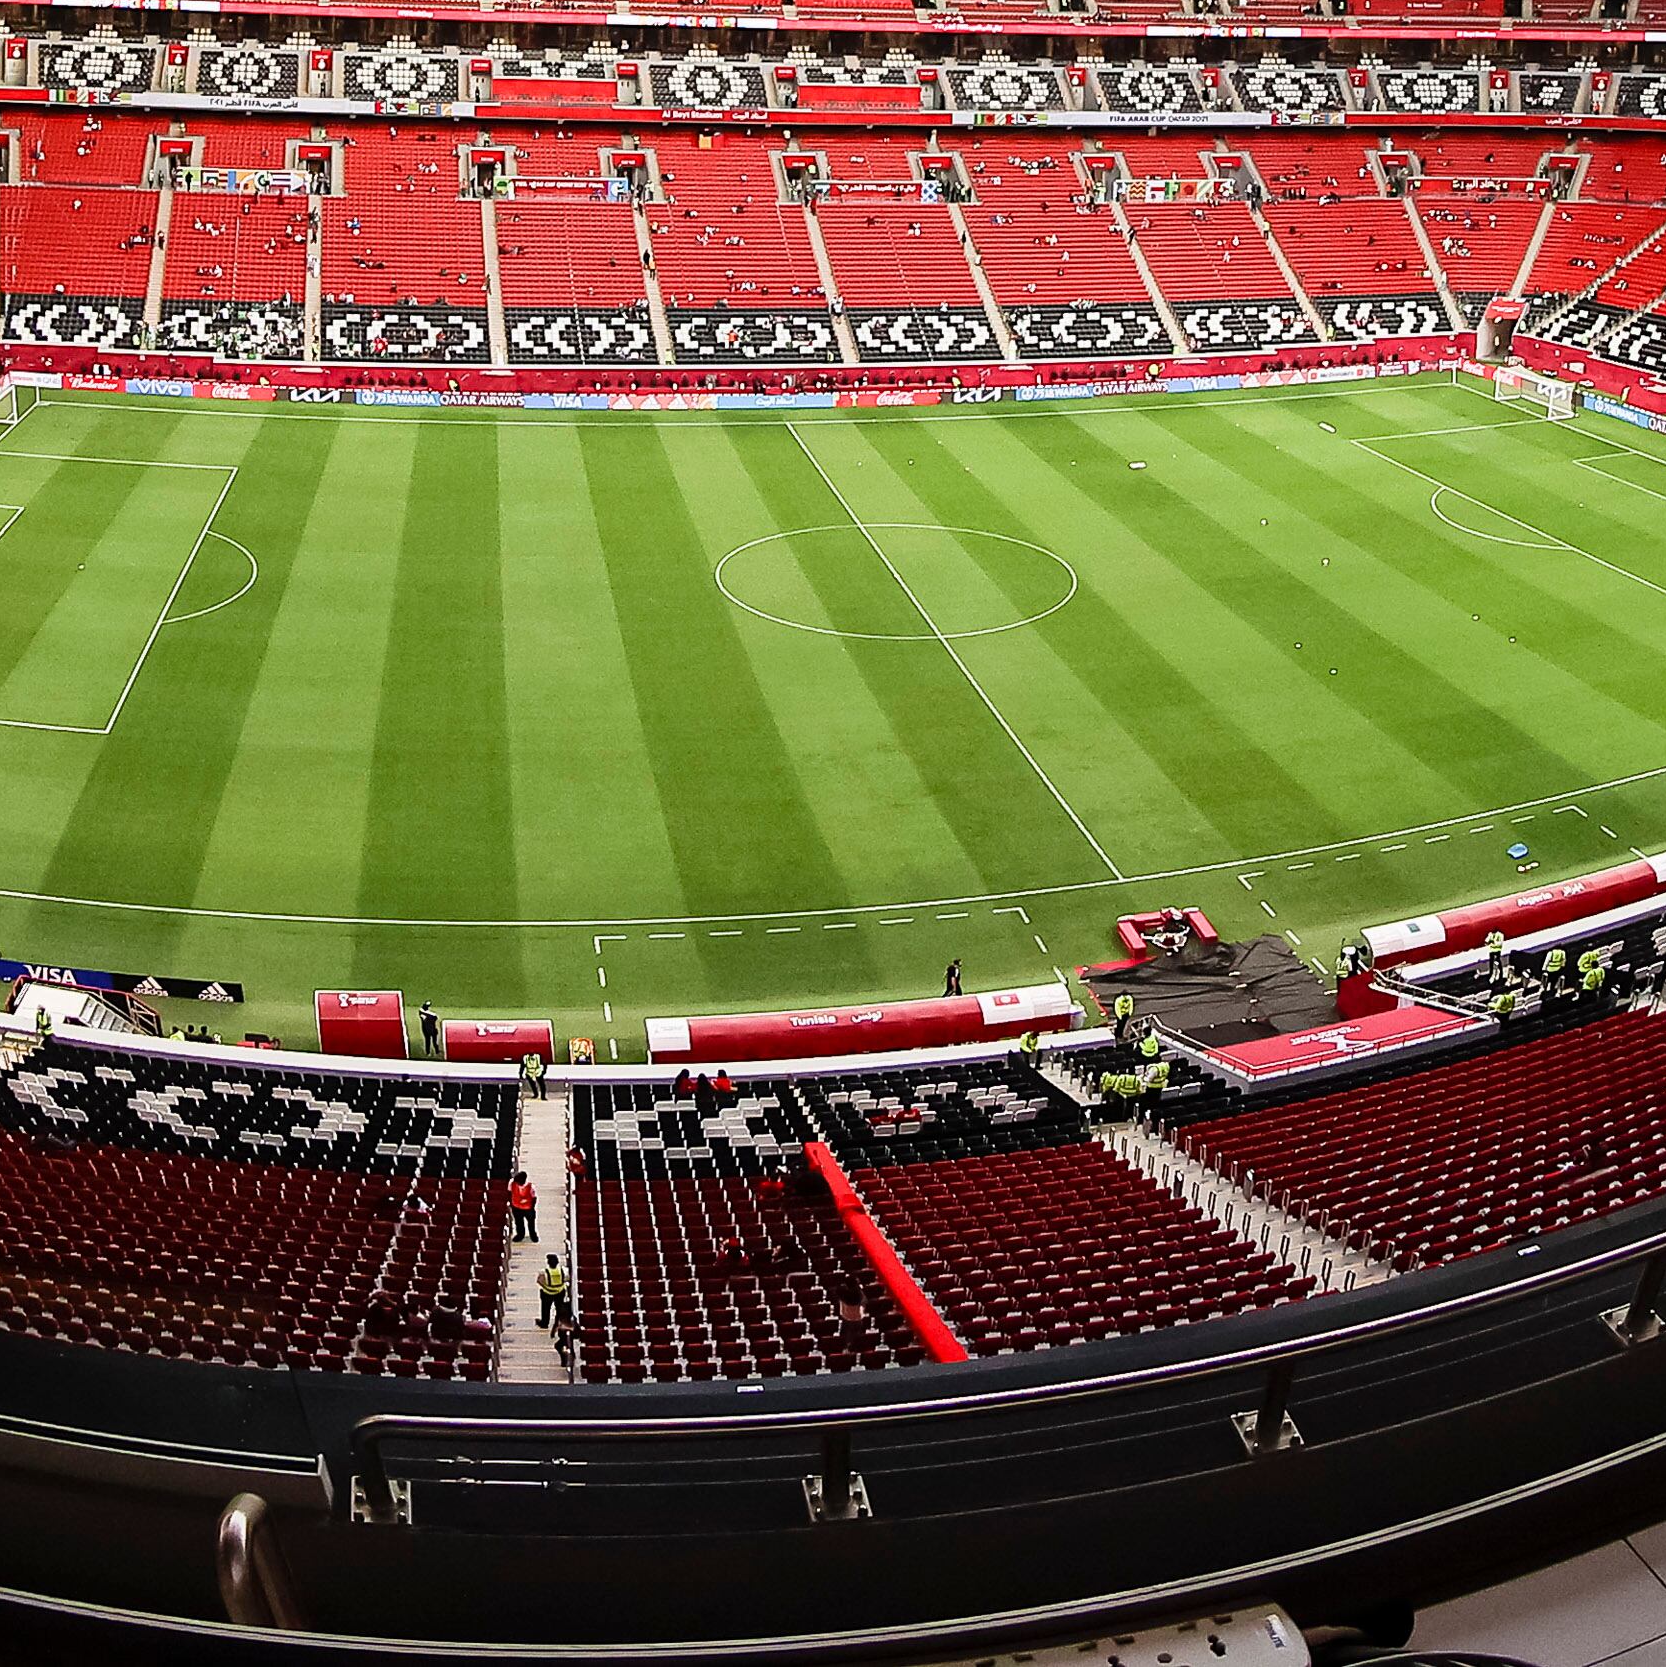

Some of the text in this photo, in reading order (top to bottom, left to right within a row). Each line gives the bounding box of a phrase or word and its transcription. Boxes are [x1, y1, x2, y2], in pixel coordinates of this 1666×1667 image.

[691, 110, 724, 120] Stadium
[69, 377, 118, 390] Budweiser
[1092, 382, 1169, 397] QATAR AIRWAYS
[1191, 378, 1218, 390] VISA
[211, 384, 251, 399] Coca-Cola
[290, 388, 342, 403] KIA
[876, 390, 914, 406] Coca-Cola
[952, 388, 1002, 404] KIA
[439, 394, 525, 407] QATAR AIRWAYS
[553, 394, 584, 408] VISA
[1516, 891, 1553, 907] Algeria
[24, 964, 78, 986] VISA
[132, 985, 168, 998] adidas
[197, 992, 234, 1003] adidas
[789, 1014, 837, 1026] Tunisia
[850, 1010, 883, 1023] تونس
